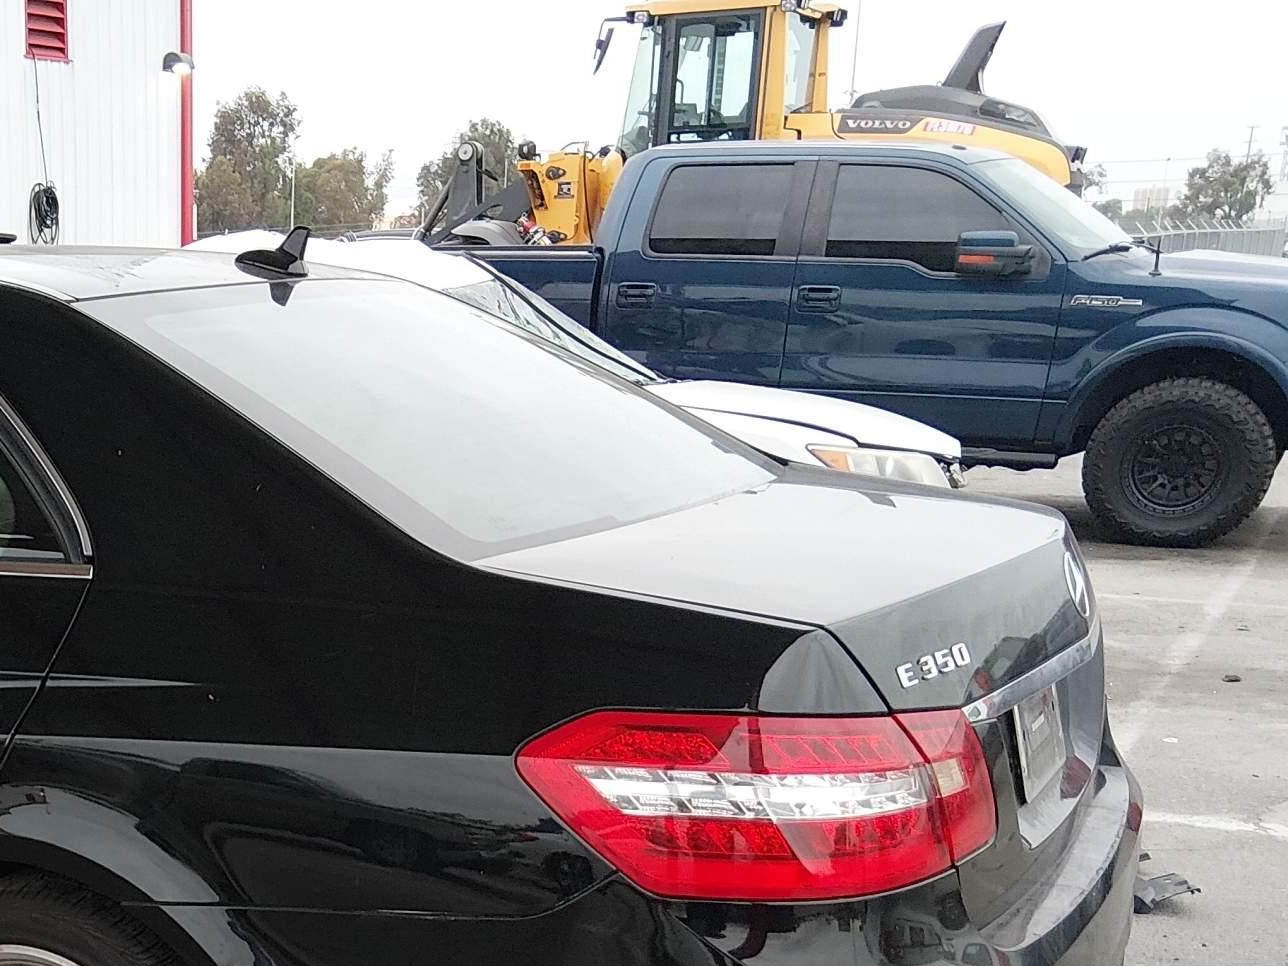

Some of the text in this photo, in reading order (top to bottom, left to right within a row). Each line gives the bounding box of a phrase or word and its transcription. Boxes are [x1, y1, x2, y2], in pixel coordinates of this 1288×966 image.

[846, 119, 911, 129] VOLVO
[895, 642, 971, 688] E 350
